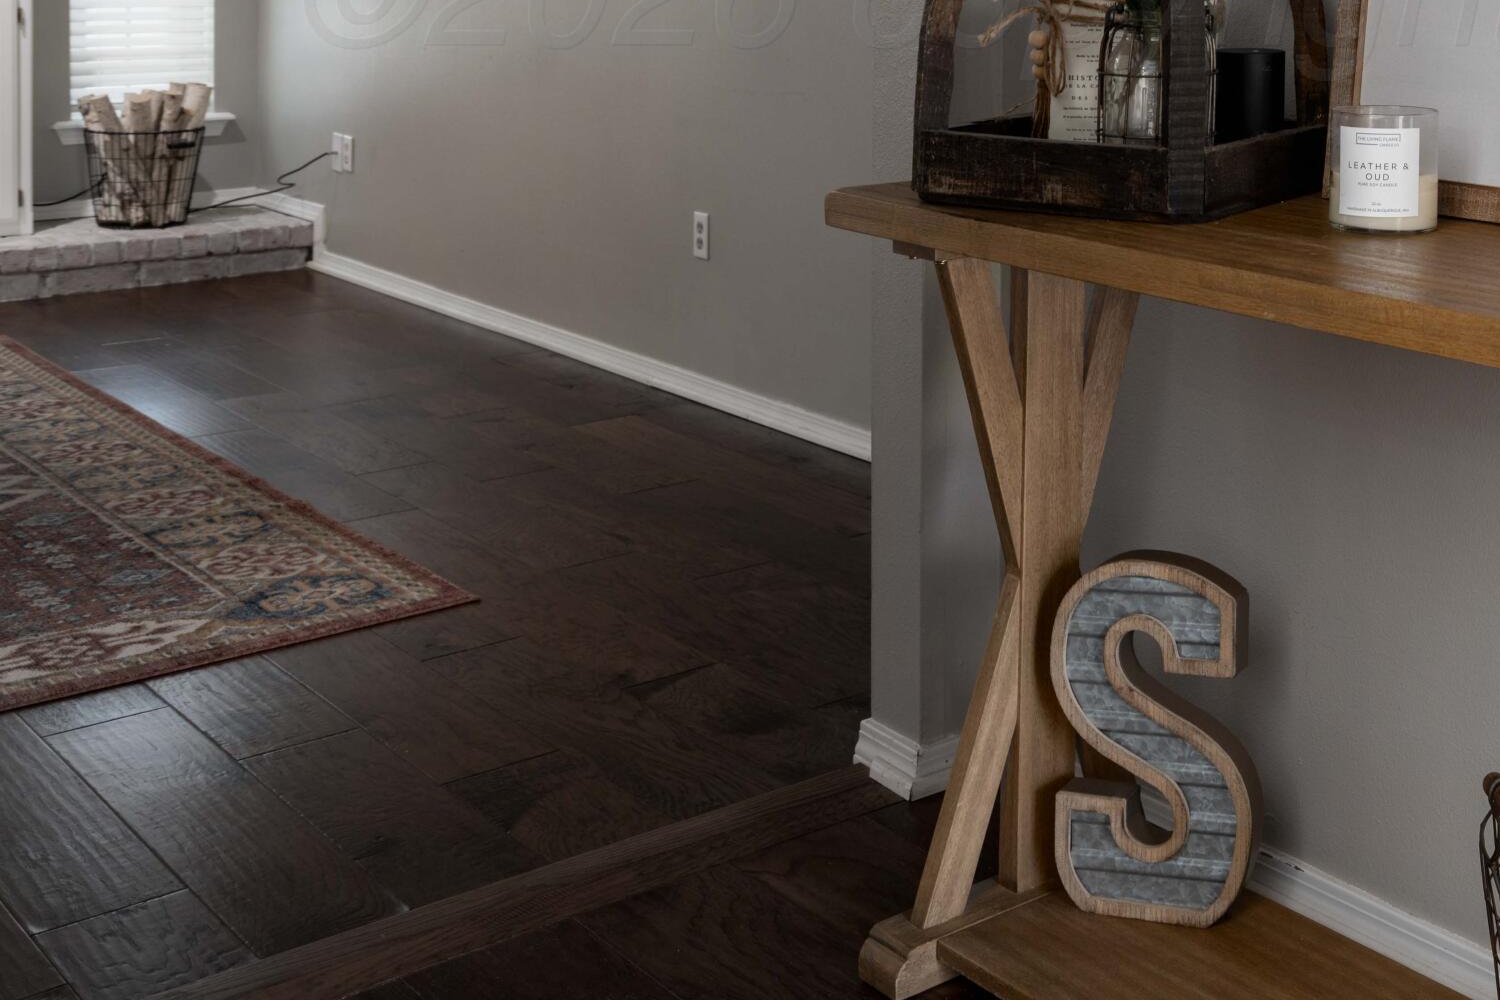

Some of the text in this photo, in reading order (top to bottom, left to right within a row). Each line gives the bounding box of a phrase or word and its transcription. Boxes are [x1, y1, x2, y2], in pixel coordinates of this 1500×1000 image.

[1348, 161, 1397, 171] LEATHER
[1365, 172, 1390, 181] OUD
[1050, 549, 1262, 929] S
